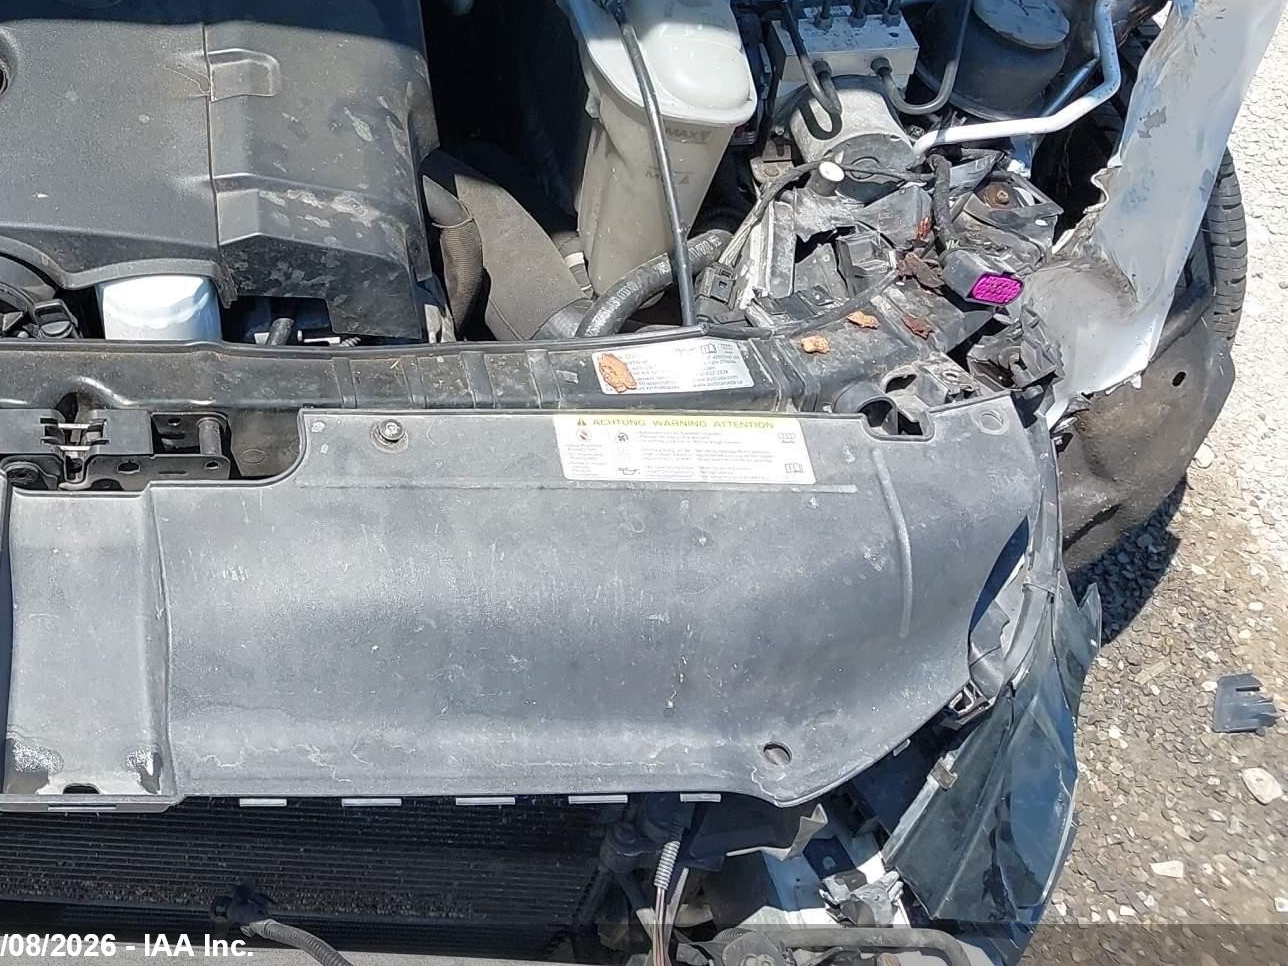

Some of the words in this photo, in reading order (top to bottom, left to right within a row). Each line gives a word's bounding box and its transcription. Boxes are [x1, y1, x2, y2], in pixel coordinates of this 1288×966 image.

[593, 419, 646, 427] ACHTUNG
[651, 419, 707, 427] WARNING
[713, 420, 774, 428] ATTENTION
